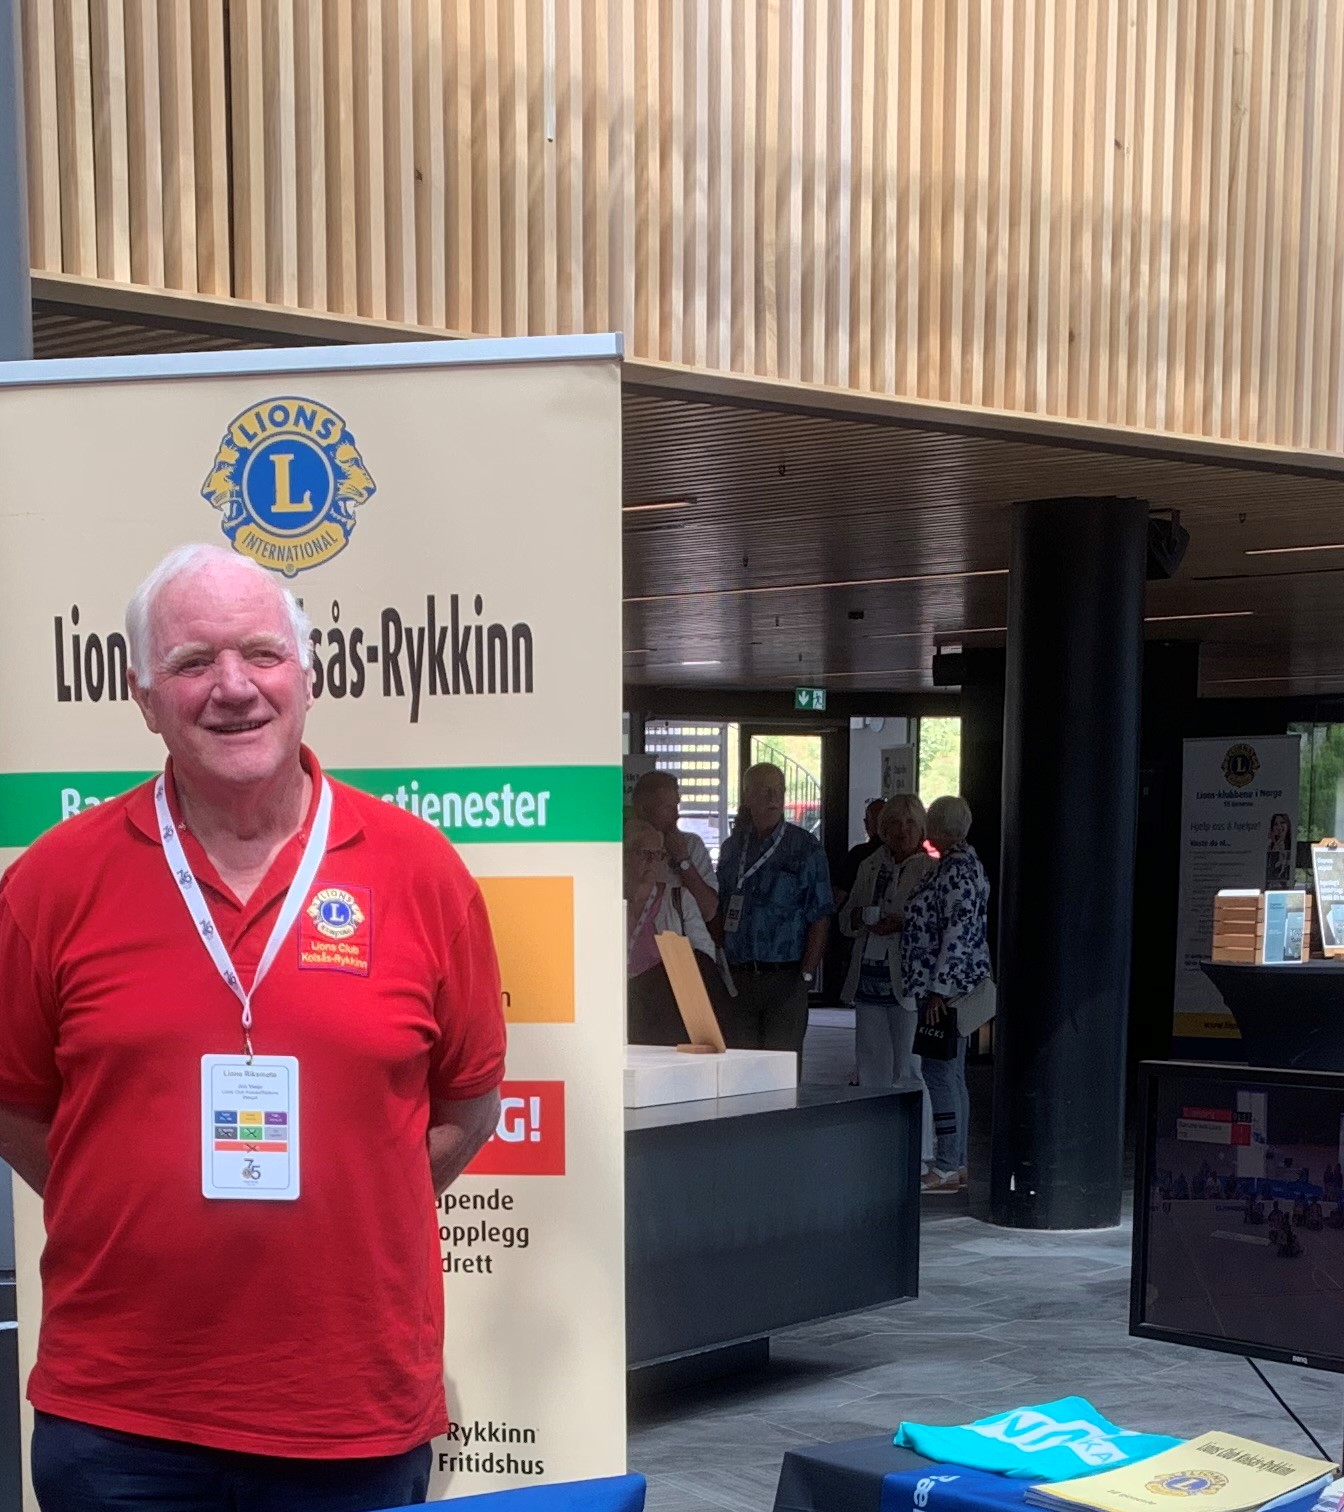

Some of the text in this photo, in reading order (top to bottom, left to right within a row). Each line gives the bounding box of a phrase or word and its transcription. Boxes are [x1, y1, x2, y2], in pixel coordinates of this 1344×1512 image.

[240, 403, 337, 443] LIONS
[269, 453, 313, 513] L
[241, 530, 339, 562] INTERNATIONAL
[54, 604, 130, 702] Lion
[321, 890, 352, 903] LIONS
[330, 903, 344, 922] L
[311, 941, 359, 954] Lions Club
[919, 1027, 945, 1039] KICKS
[244, 1158, 261, 1180] 75
[440, 1252, 493, 1275] drett
[447, 1419, 537, 1452] Rykkinn
[438, 1452, 545, 1476] Fritidshus
